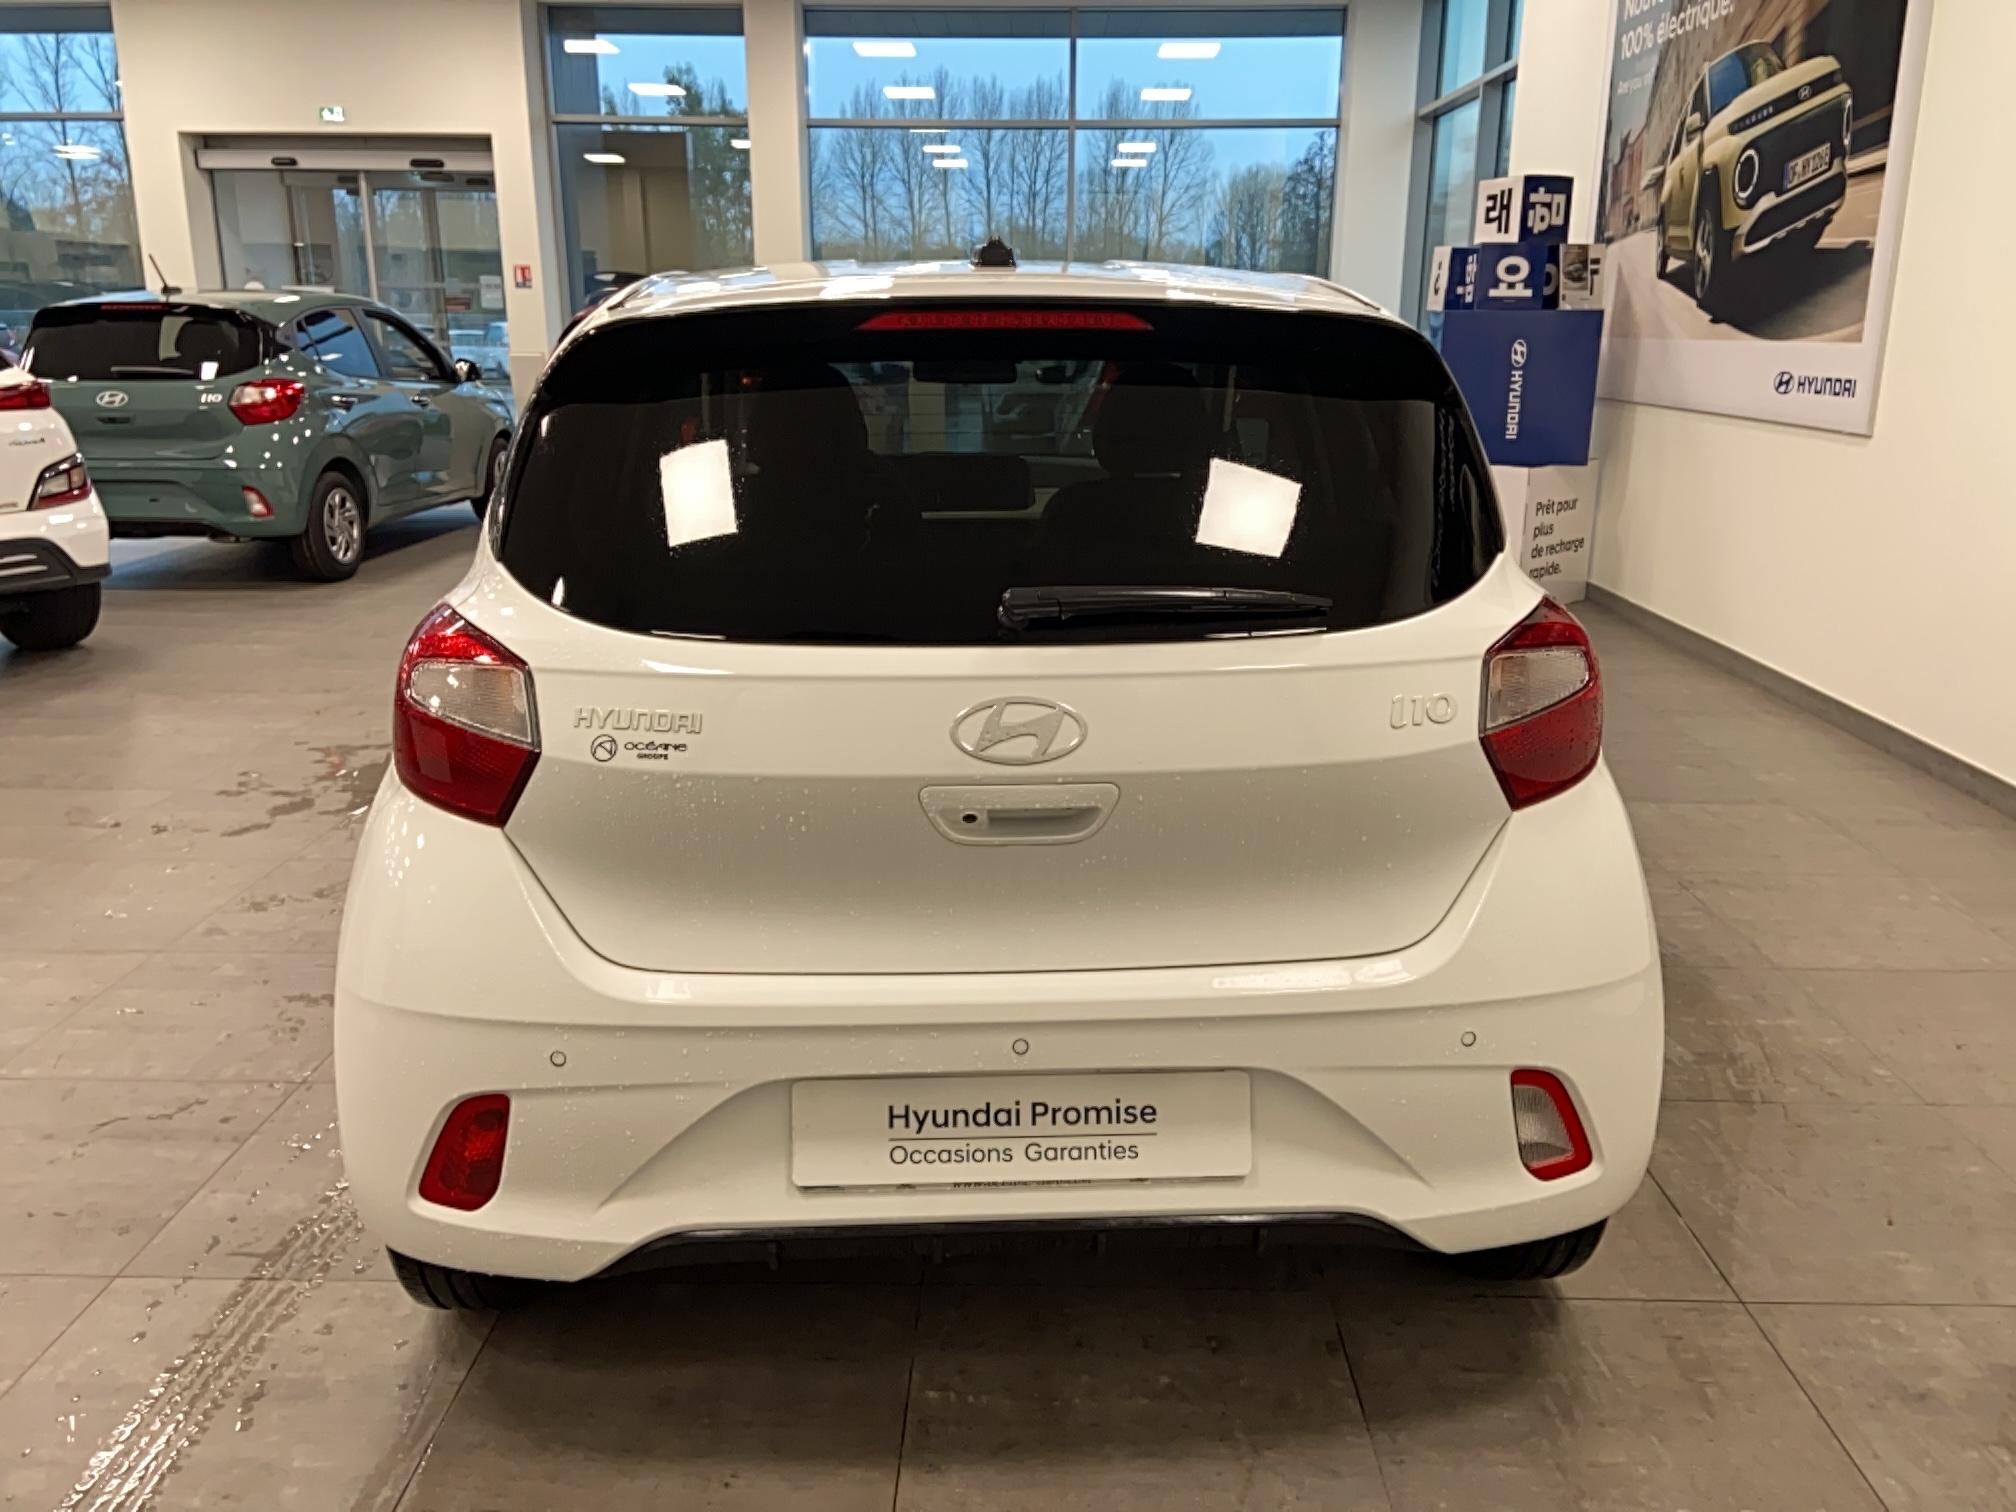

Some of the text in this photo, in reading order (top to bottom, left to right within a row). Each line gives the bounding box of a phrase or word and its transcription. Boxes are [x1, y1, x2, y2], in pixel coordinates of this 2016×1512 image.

[1621, 21, 1654, 60] 100%
[1484, 188, 1512, 234] 래
[1797, 375, 1857, 398] HYUNDAI
[1505, 370, 1523, 439] HYUNDAI
[1556, 498, 1578, 516] pour
[1533, 523, 1554, 541] plus
[1531, 537, 1585, 559] de recharge
[1529, 561, 1562, 580] rapide.
[573, 705, 703, 734] HYUNDAI
[888, 1098, 1157, 1134] Hyundai Promise
[889, 1140, 1139, 1165] Occasions Garanties
